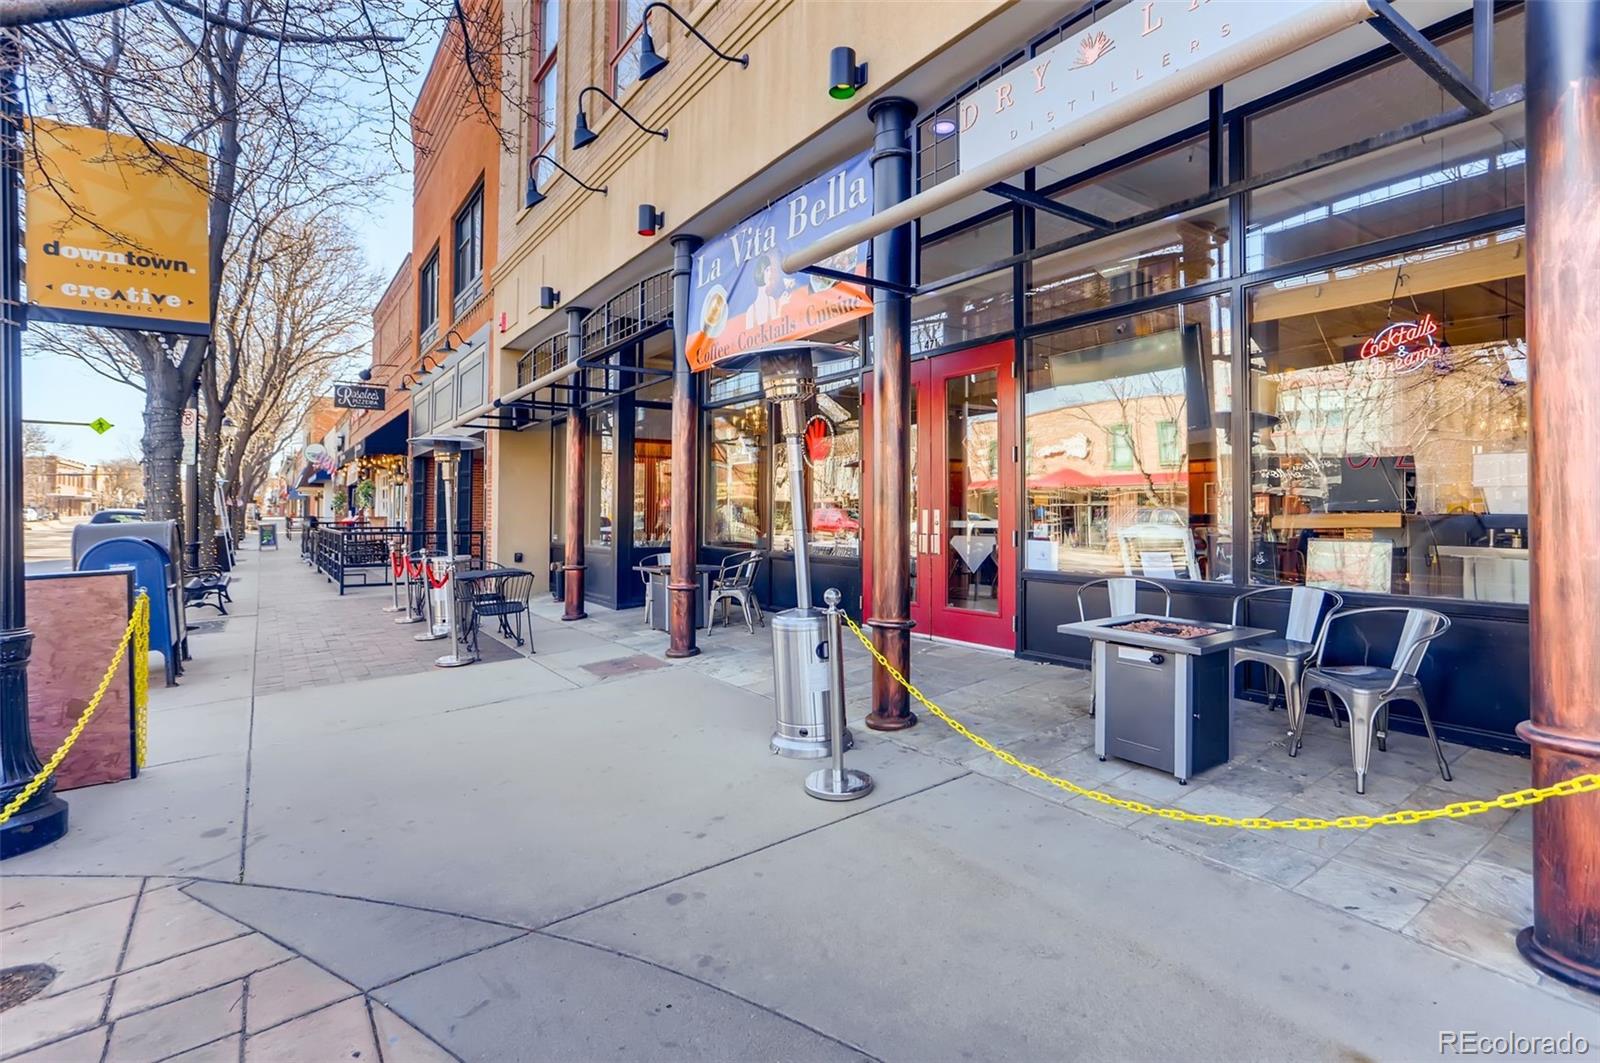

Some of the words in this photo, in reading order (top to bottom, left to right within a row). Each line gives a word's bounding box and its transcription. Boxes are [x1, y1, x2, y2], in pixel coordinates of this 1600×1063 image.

[960, 57, 1051, 135] DRY
[1009, 23, 1231, 140] DISTILLERS
[696, 253, 722, 289] La
[729, 224, 776, 268] Vita
[787, 170, 867, 240] Bella
[76, 262, 168, 278] LONGMONT
[81, 299, 164, 313] DISTRICT
[696, 343, 730, 365] Coffee
[737, 315, 797, 350] Cocktails
[806, 294, 863, 326] Cuisine
[924, 339, 938, 349] 471
[1360, 313, 1438, 360] Cocktails
[1369, 343, 1441, 379] Dreams
[1394, 345, 1409, 357] &
